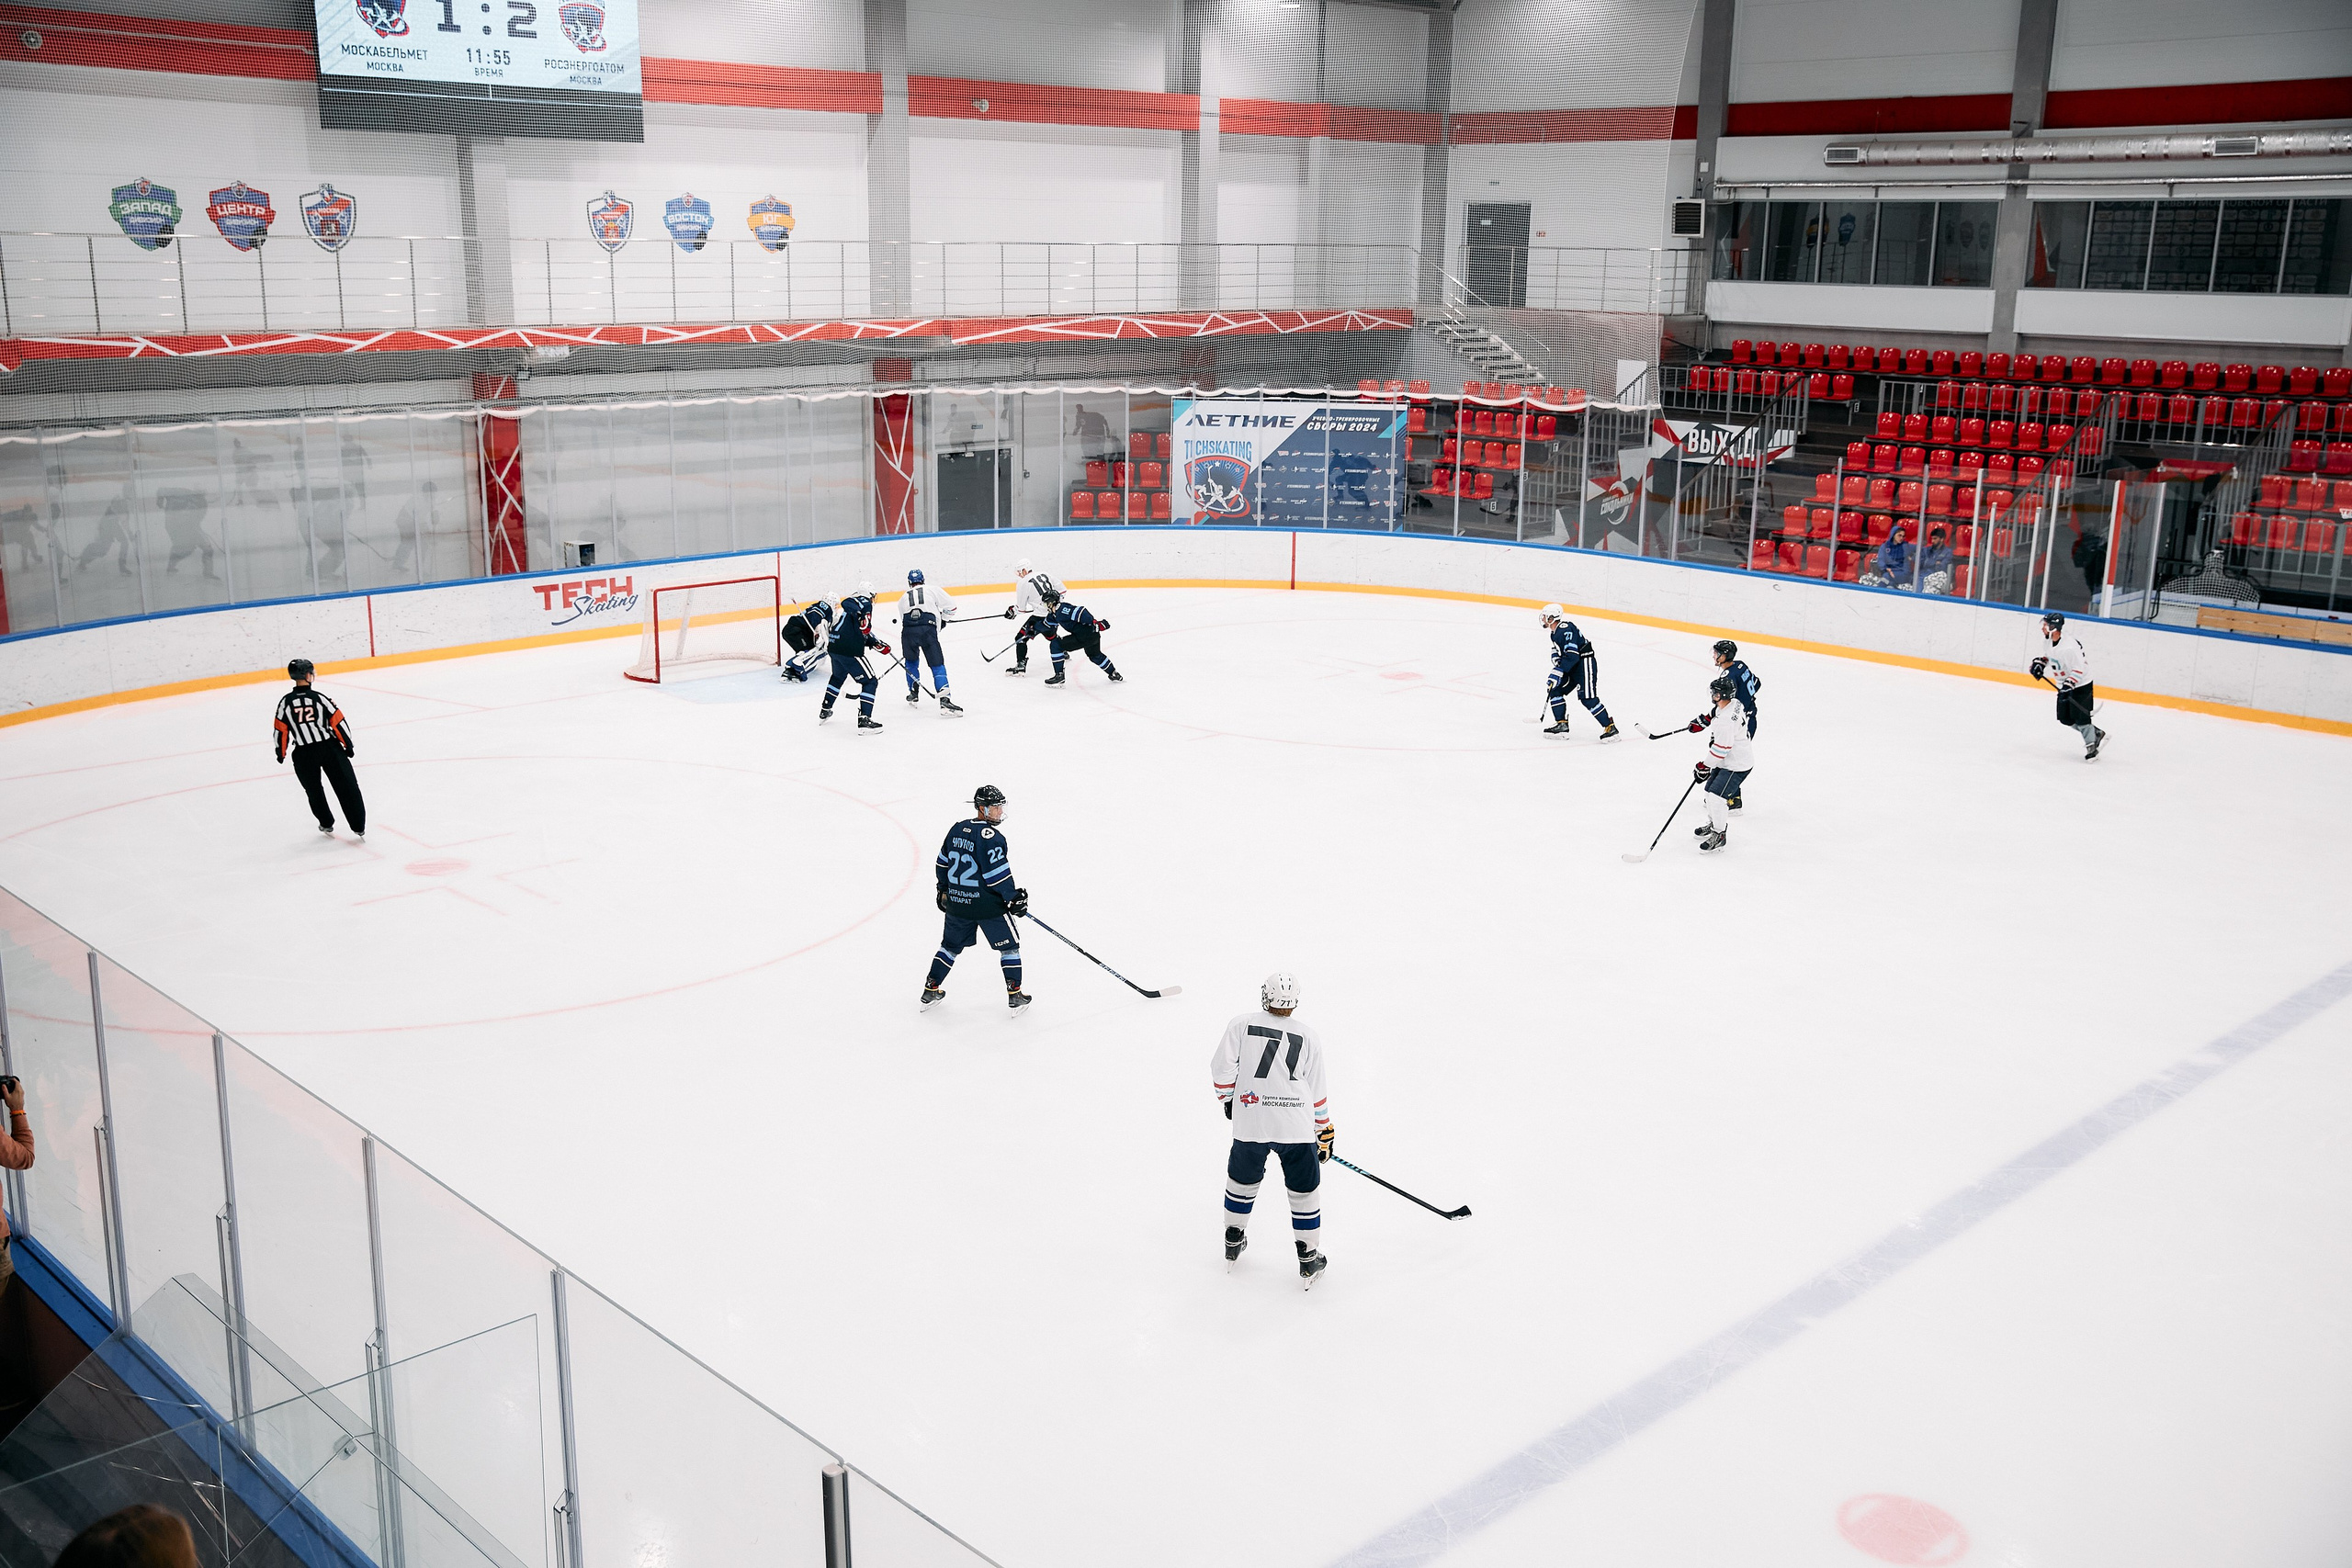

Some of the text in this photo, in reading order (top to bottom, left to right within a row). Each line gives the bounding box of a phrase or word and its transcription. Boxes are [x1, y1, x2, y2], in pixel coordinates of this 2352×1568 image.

[341, 44, 429, 61] МОСКАБЕЛЬМЕТ
[466, 48, 512, 65] 11:55
[367, 62, 404, 73] МОСКВА
[475, 68, 503, 78] ВРЕМЯ
[544, 59, 625, 74] РОСЭНЕРГОАТОМ
[570, 75, 603, 86] МОСКВА
[120, 203, 173, 217] ЗАПАД
[217, 204, 266, 218] ЦЕНТР
[667, 214, 709, 225] ВОСТОК
[763, 214, 778, 224] ЮГ
[1184, 414, 1297, 428] ЛЕТНИЕ
[1348, 423, 1377, 432] 2024
[532, 575, 633, 611] TECH
[906, 587, 925, 607] 11
[550, 594, 639, 626] Skating
[294, 706, 316, 723] 72
[987, 846, 1005, 864] 22
[947, 851, 979, 887] 22
[1247, 1024, 1304, 1081] 71
